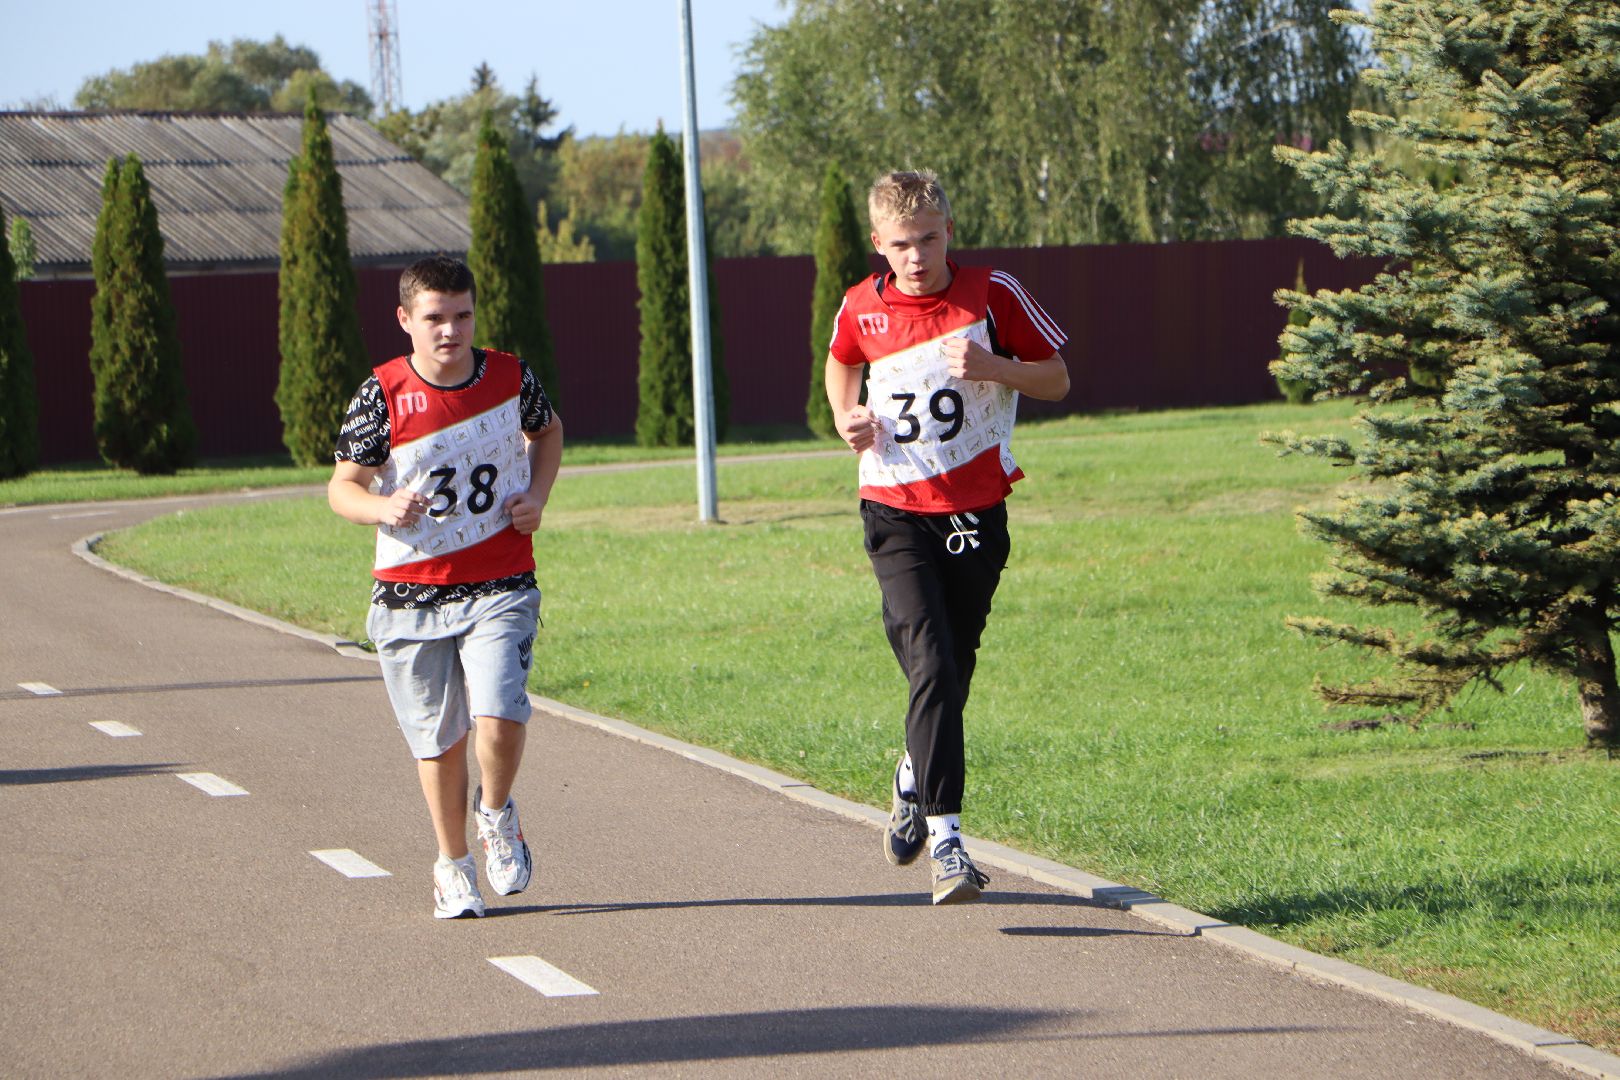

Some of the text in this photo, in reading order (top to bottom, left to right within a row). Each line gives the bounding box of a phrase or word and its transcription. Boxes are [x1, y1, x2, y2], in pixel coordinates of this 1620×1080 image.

[396, 390, 428, 416] ГТО
[891, 388, 964, 444] 39
[426, 463, 499, 517] 38
